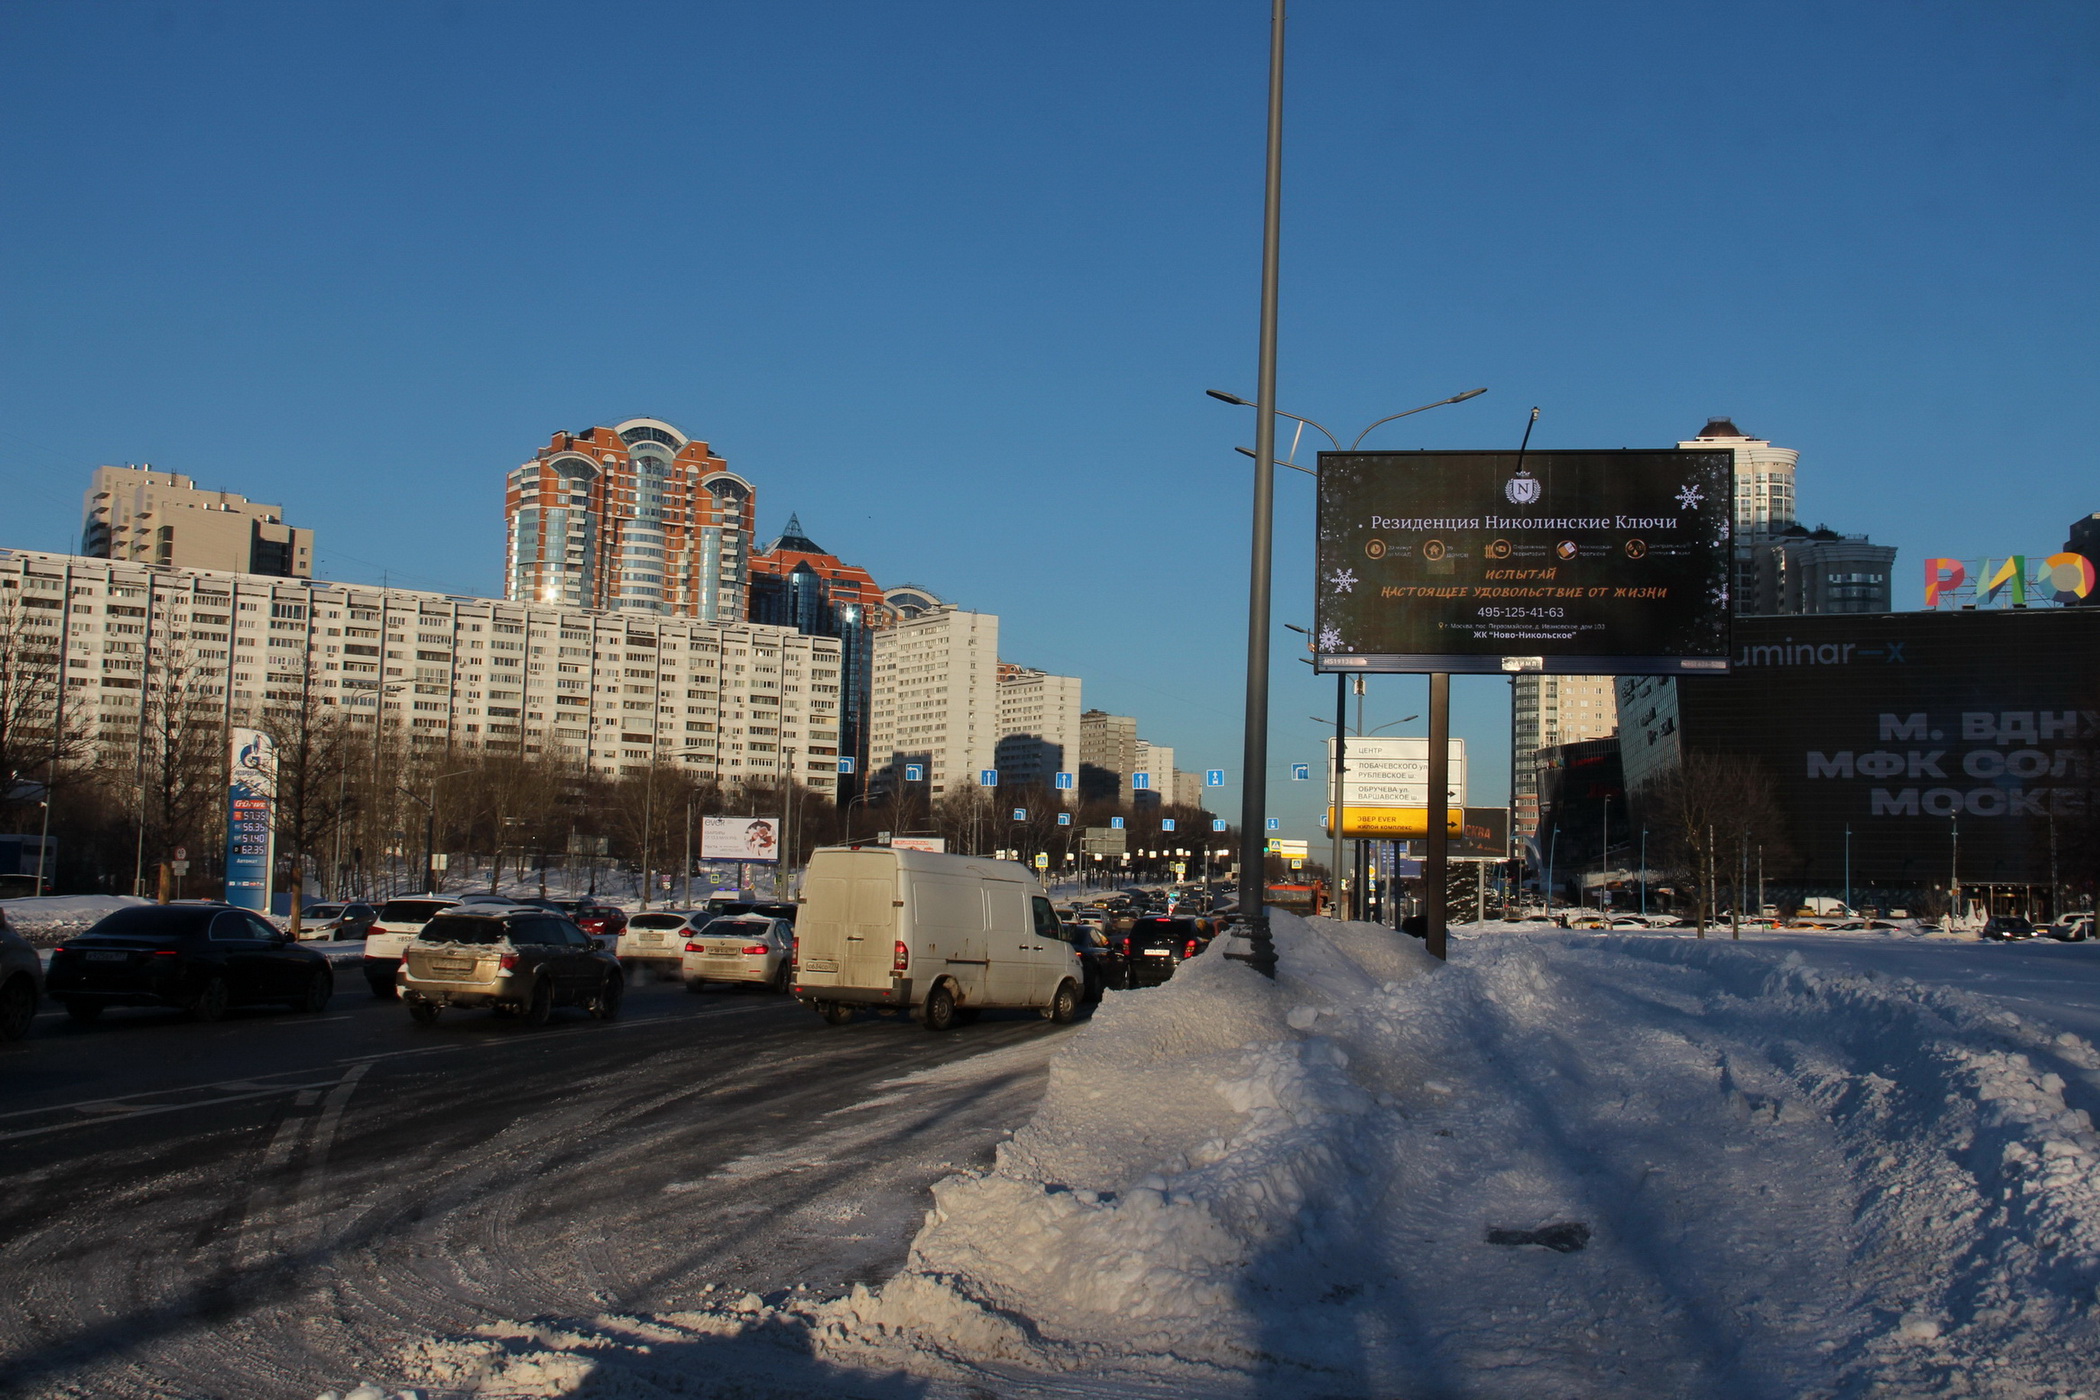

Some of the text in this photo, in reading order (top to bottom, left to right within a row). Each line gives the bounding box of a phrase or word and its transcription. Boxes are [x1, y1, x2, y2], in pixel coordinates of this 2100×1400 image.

[1518, 483, 1529, 495] N
[1371, 515, 1677, 532] Резиденция Николинские Ключи
[1485, 567, 1557, 580] ИСПЫТАЙ
[1925, 552, 2096, 606] РИО
[1381, 586, 1668, 599] НАСТОЯЩЕЕ УДОВОЛЬСТВИЕ ОТ ЖИЗНИ
[1477, 606, 1564, 618] 495-125-41-63
[1473, 631, 1488, 639] ЖК
[1879, 712, 1945, 741] М.
[1358, 747, 1383, 755] ЦЕНТР
[1358, 762, 1418, 770] ЛОБАЧЕВСКОГО
[1807, 750, 1947, 778] МФК
[1358, 771, 1406, 779] РУБЛЕВСКОЕ
[1358, 793, 1409, 801] ВАРШАВСКОЕ
[242, 845, 264, 855] 62.35
